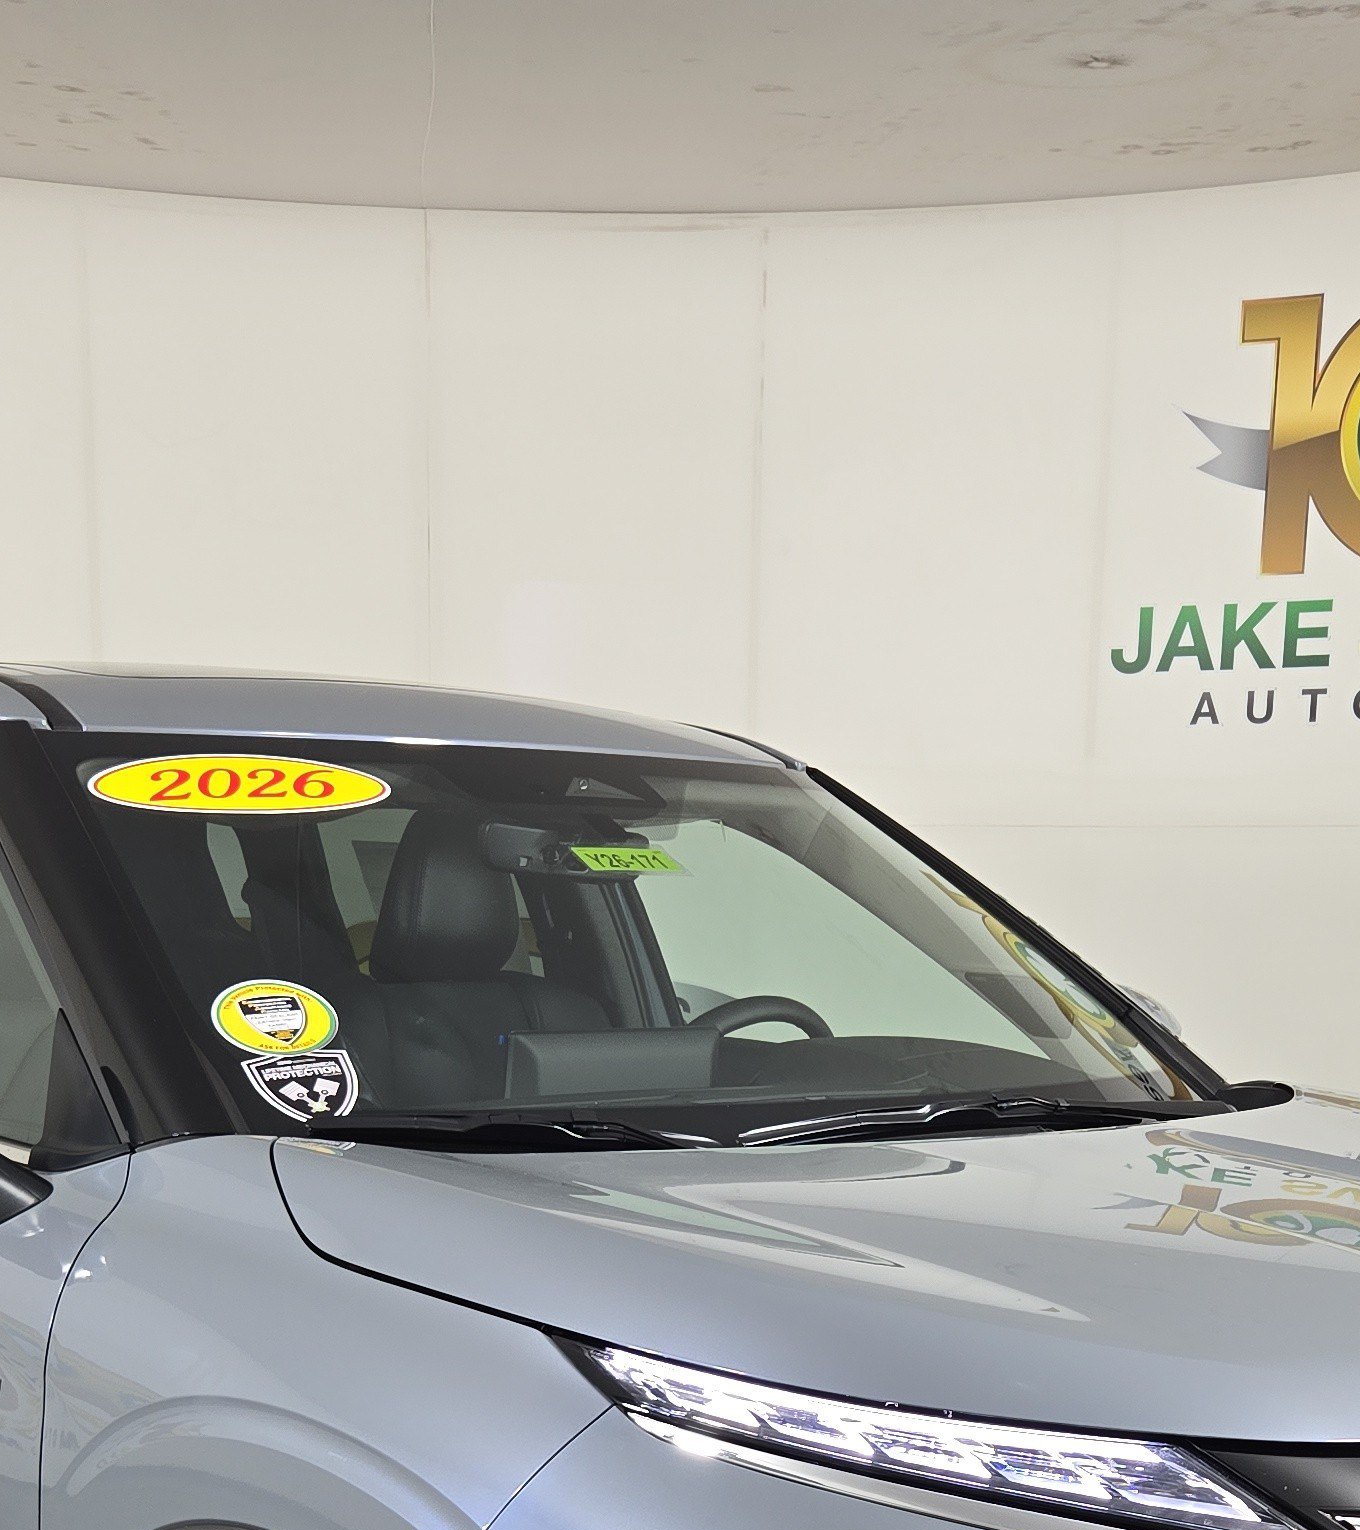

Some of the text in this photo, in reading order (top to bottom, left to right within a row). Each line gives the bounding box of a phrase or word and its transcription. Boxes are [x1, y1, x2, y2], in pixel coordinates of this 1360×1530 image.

[1110, 598, 1334, 675] JAKE
[149, 767, 336, 802] 2026
[584, 853, 669, 869] Y26-171
[262, 1065, 343, 1082] PROTECTION
